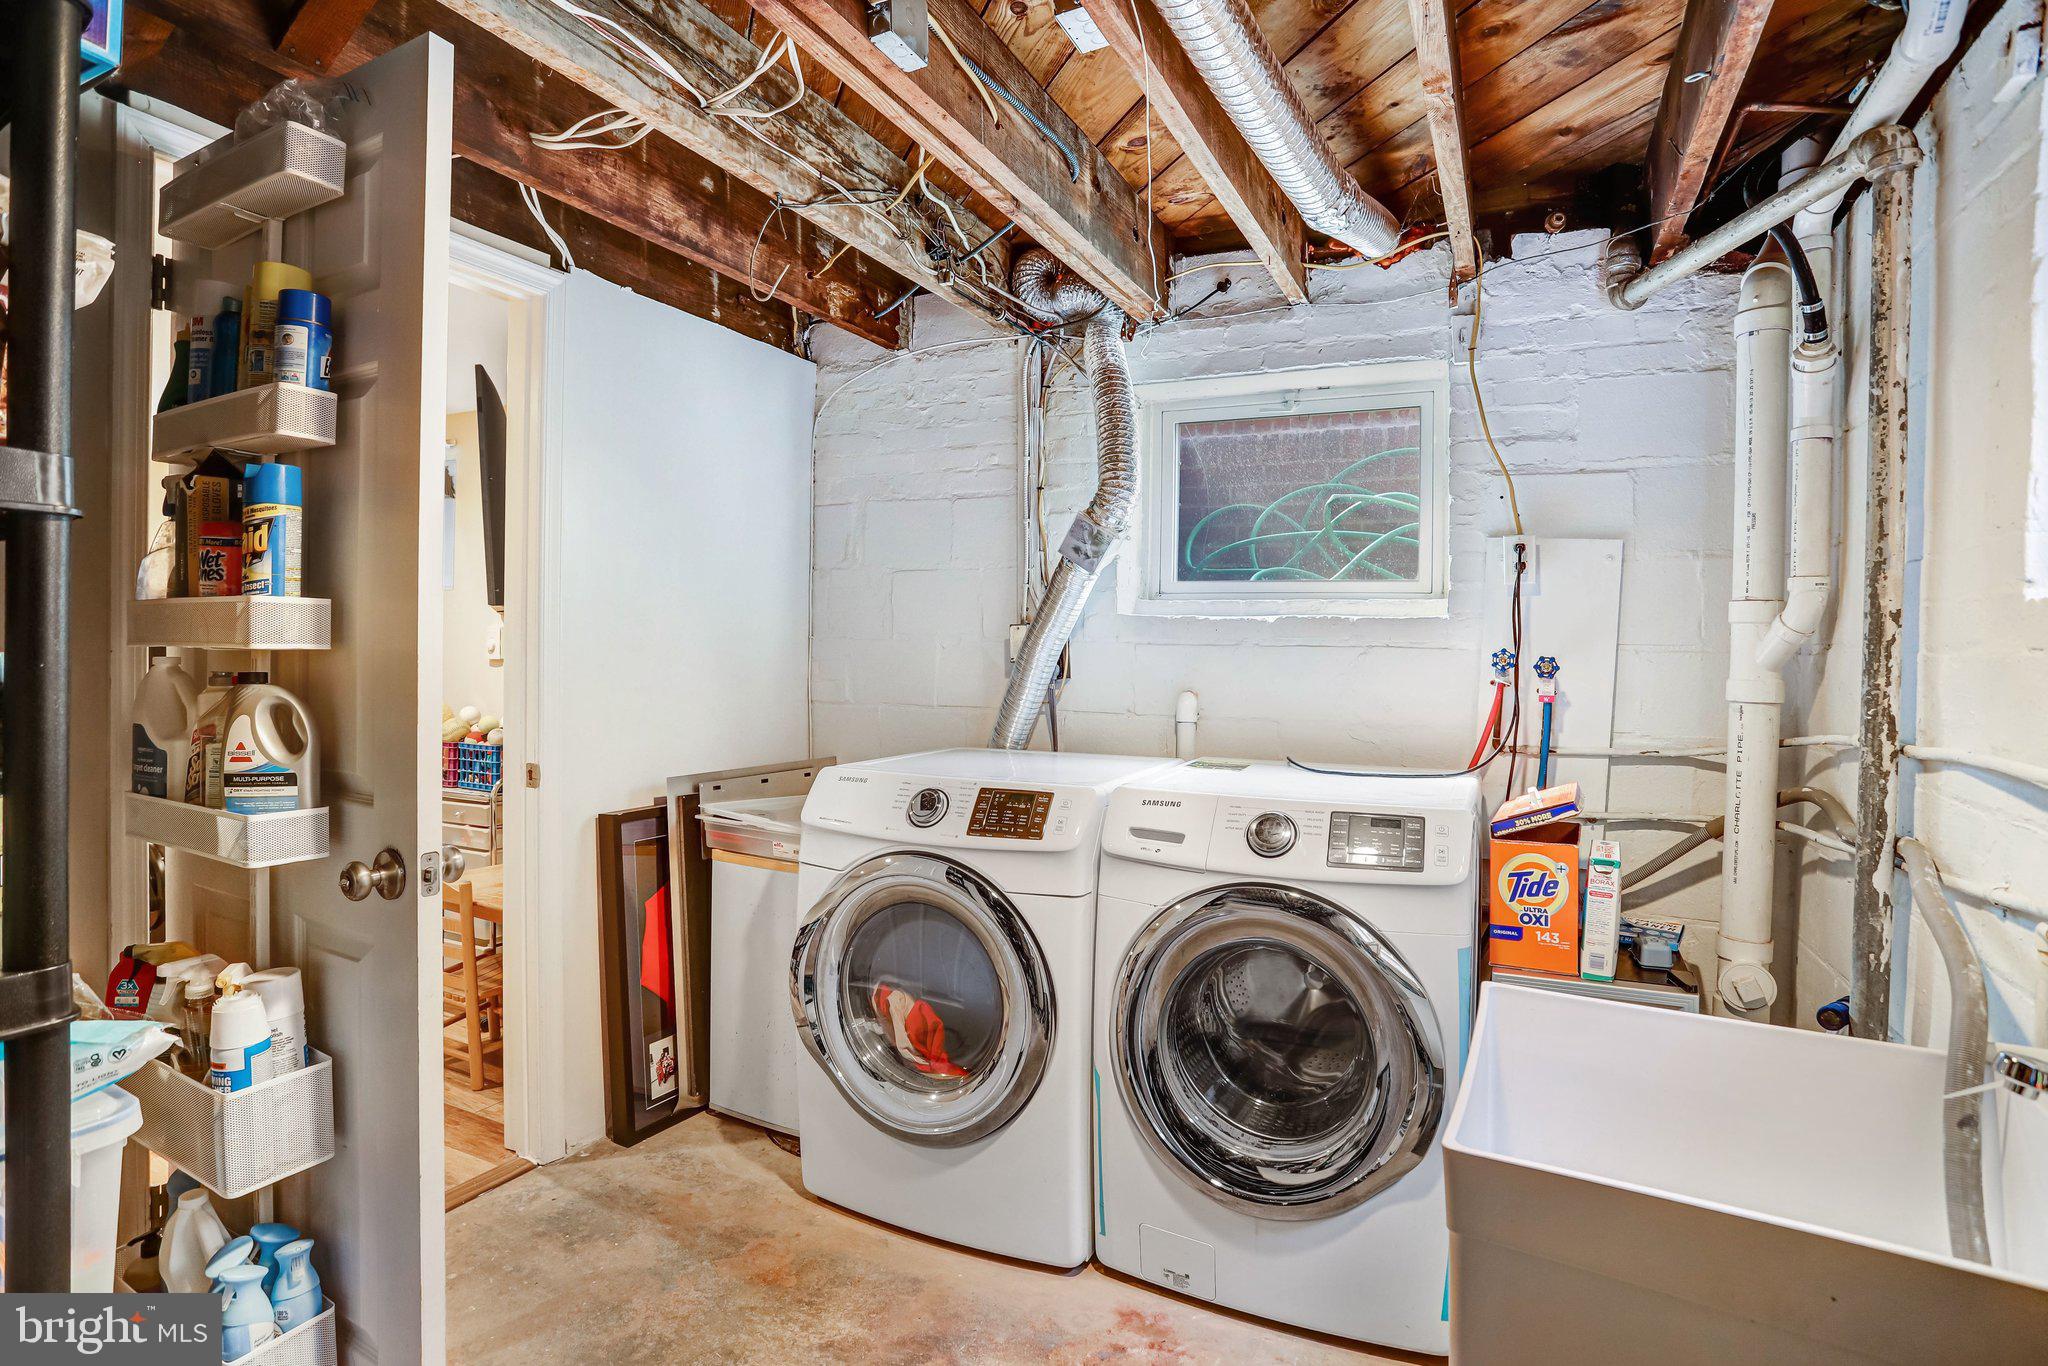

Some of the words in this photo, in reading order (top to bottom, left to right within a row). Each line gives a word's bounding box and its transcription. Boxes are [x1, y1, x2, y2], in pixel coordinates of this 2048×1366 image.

[212, 482, 222, 514] GLOVES
[242, 522, 270, 555] aid
[200, 568, 224, 582] nes
[144, 764, 163, 773] cleaner
[1142, 800, 1182, 808] SAMSUNG
[1530, 812, 1552, 823] MORE
[1507, 870, 1560, 903] Tide
[1590, 878, 1616, 887] BORAX
[1519, 914, 1549, 926] OXI
[1536, 931, 1560, 944] 143
